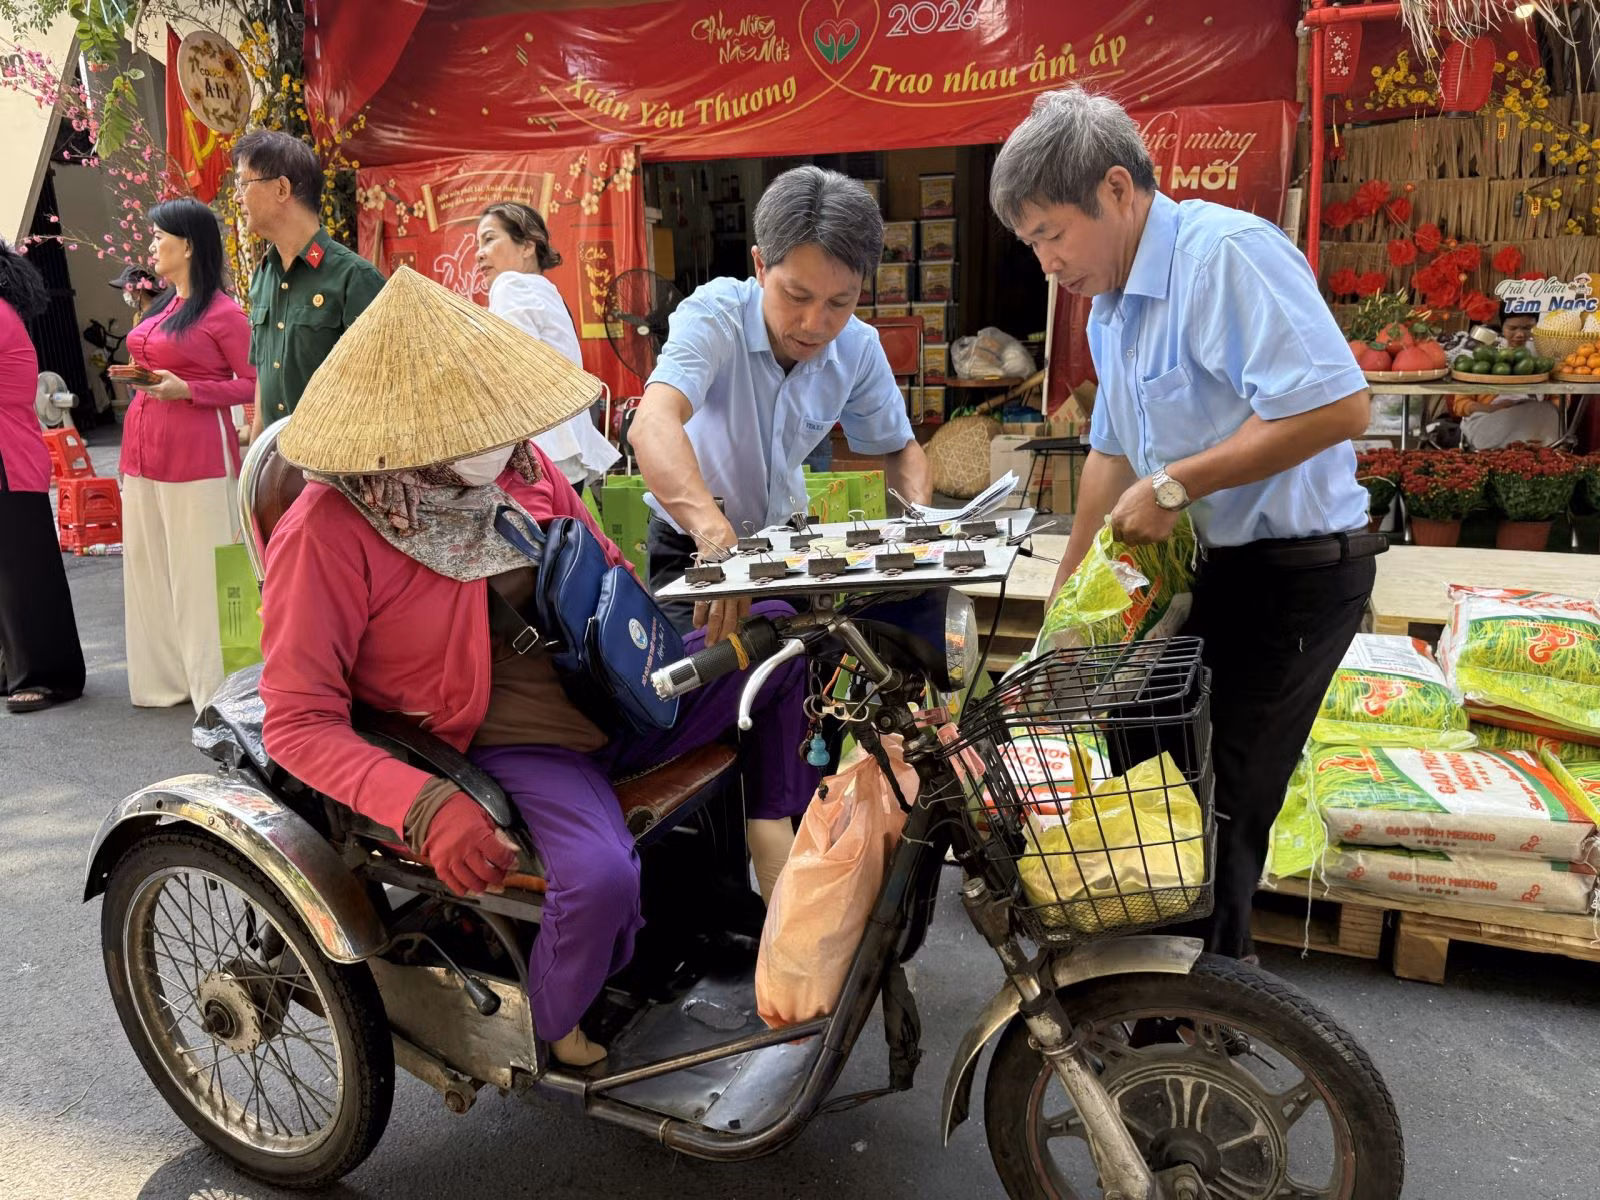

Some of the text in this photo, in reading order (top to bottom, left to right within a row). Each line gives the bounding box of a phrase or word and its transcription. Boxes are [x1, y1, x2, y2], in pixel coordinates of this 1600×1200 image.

[886, 0, 978, 37] 2026
[868, 33, 1127, 95] Trao nhau ấm áp
[565, 72, 797, 128] Xuân Yêu Thương
[1184, 126, 1257, 168] mừng
[1171, 159, 1239, 190] MỚI
[1504, 296, 1541, 312] Tâm
[1447, 830, 1496, 842] MEKONG
[1449, 877, 1498, 890] MEKONG
